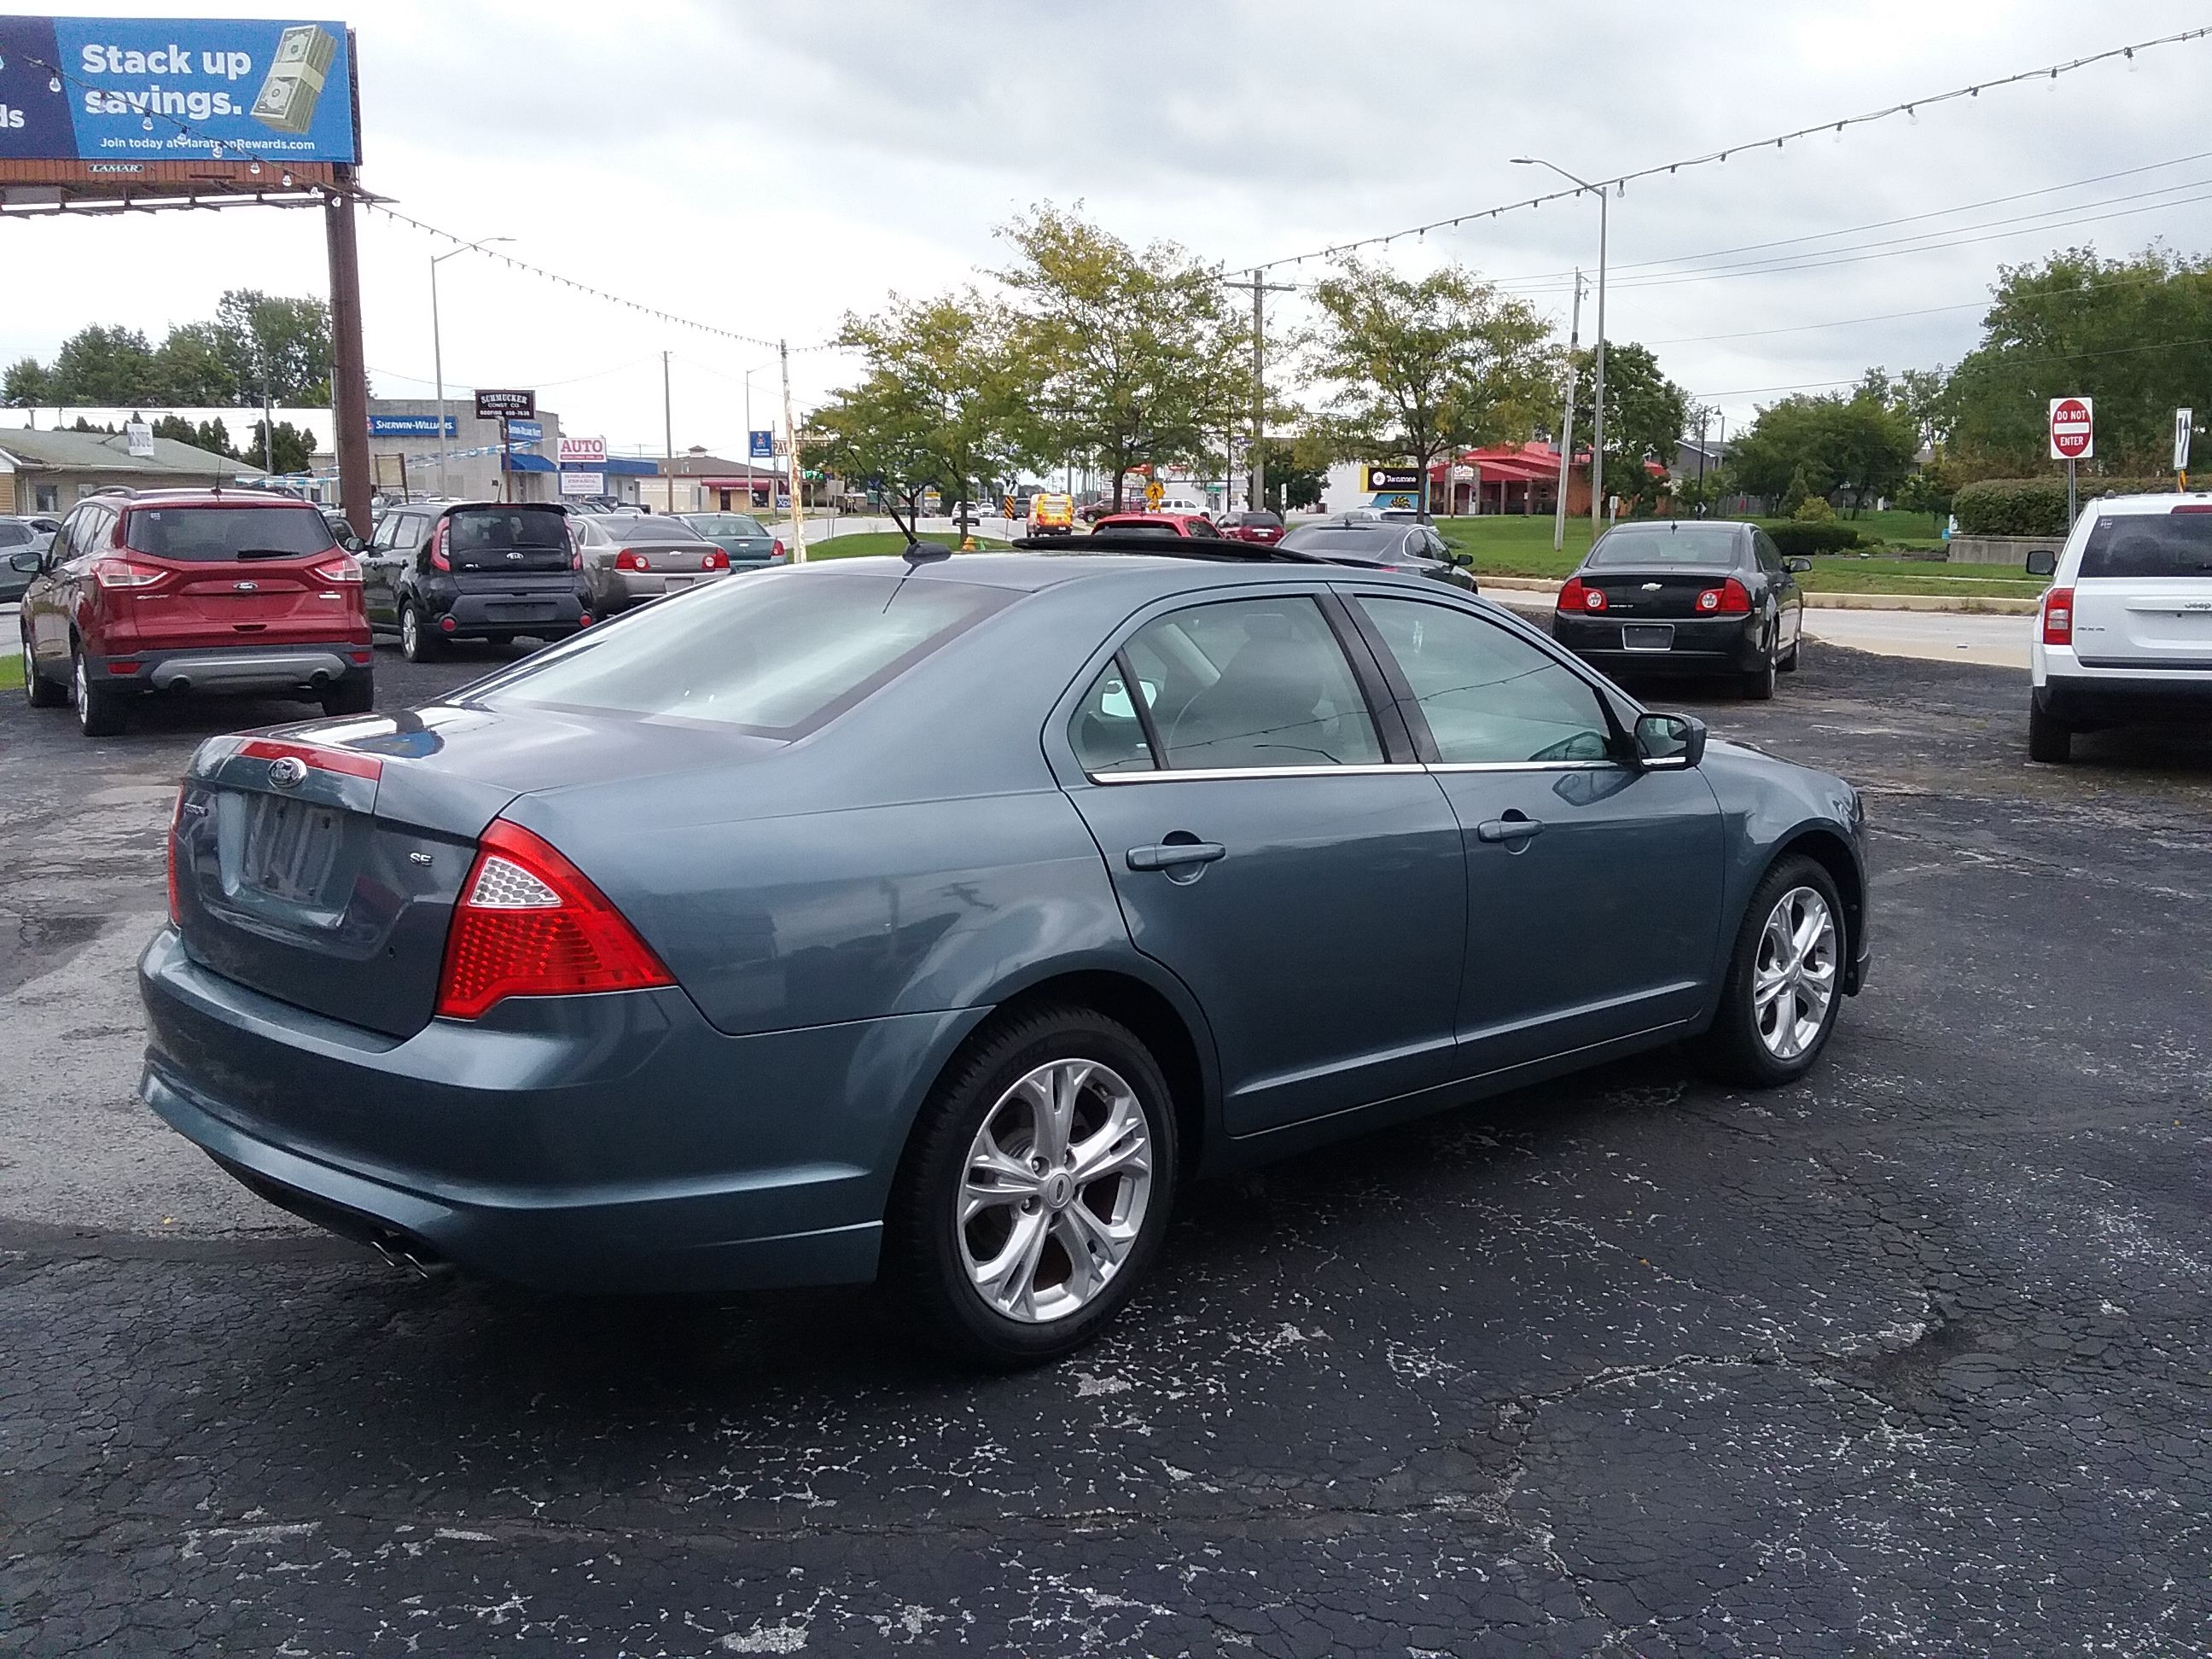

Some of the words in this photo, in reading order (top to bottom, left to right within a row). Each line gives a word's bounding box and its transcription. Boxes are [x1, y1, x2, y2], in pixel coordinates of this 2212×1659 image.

[82, 44, 192, 74] Stack
[202, 51, 252, 80] up
[84, 84, 242, 120] savings.
[101, 138, 126, 148] Join
[129, 138, 162, 150] today
[166, 138, 178, 148] at
[181, 138, 316, 151] MaratnRewards.com
[480, 393, 527, 405] SCHMUCKER
[2057, 410, 2069, 421] DO
[2070, 410, 2087, 420] NOT
[561, 439, 603, 453] AUTO
[2060, 435, 2084, 446] ENTER
[410, 853, 432, 865] SE
